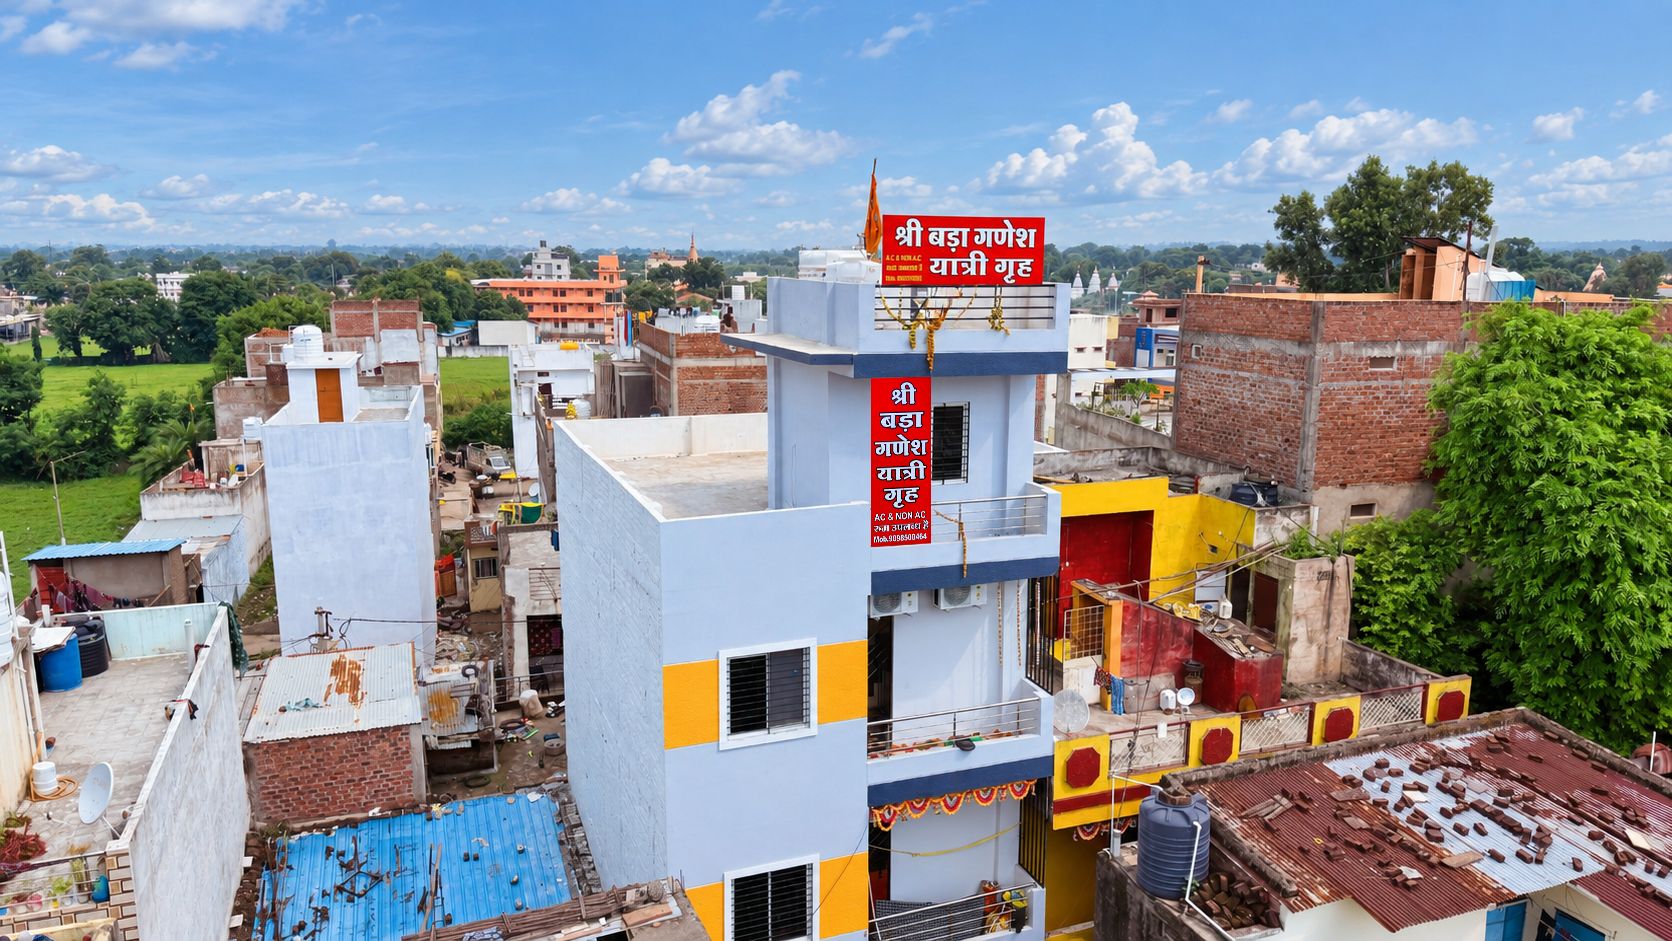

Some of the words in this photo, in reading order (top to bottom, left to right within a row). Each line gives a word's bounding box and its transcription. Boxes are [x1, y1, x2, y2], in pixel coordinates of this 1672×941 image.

[895, 218, 924, 247] श्री
[928, 227, 970, 253] बड़ा
[974, 219, 1037, 248] गणेश
[929, 250, 989, 276] यात्री
[995, 259, 1034, 284] गृह
[892, 381, 916, 405] श्री
[880, 411, 924, 432] बड़ा
[875, 434, 928, 457] गणेश
[877, 460, 926, 481] यात्री
[884, 486, 919, 508] गृह
[874, 513, 886, 522] AC
[887, 512, 893, 521] &
[895, 511, 913, 520] NON
[914, 510, 926, 519] AC
